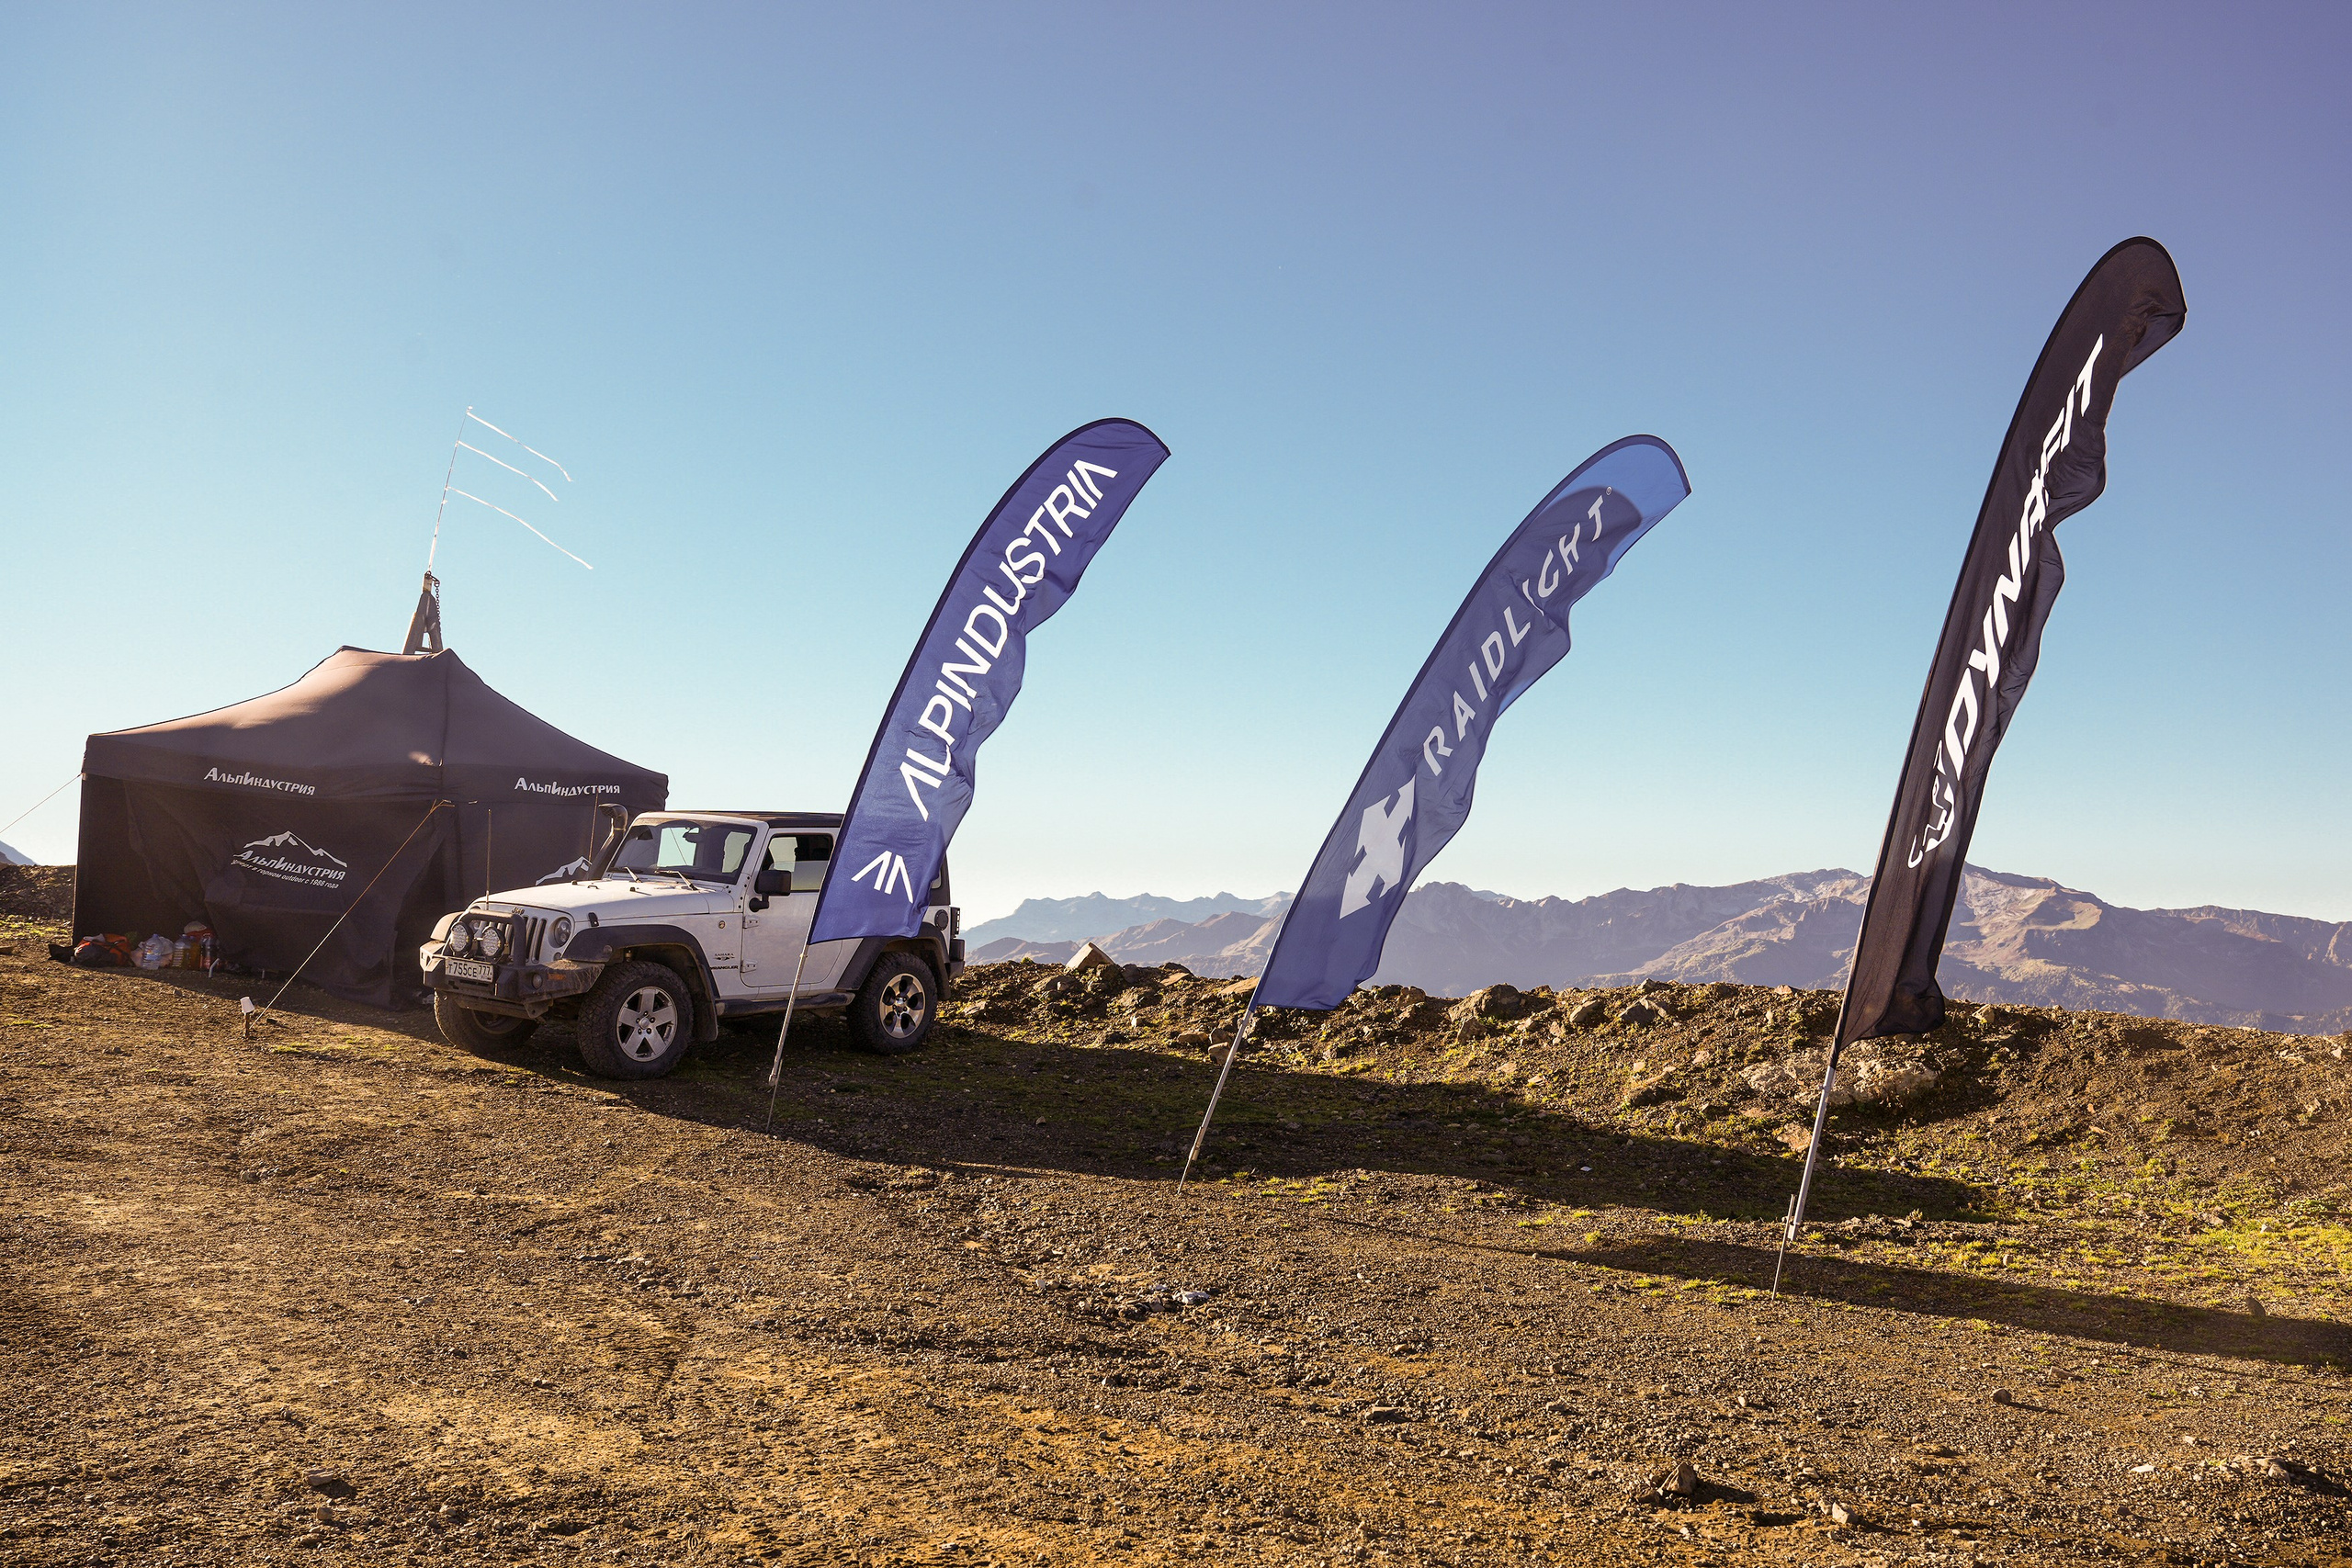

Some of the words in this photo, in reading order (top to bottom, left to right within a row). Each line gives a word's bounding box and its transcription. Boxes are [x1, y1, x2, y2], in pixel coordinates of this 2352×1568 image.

[899, 458, 1119, 822] ALPINDUSTRIA
[1422, 493, 1605, 777] RAIDLIGHT
[1945, 333, 2104, 782] DYNAFIT
[281, 874, 305, 883] outdoor
